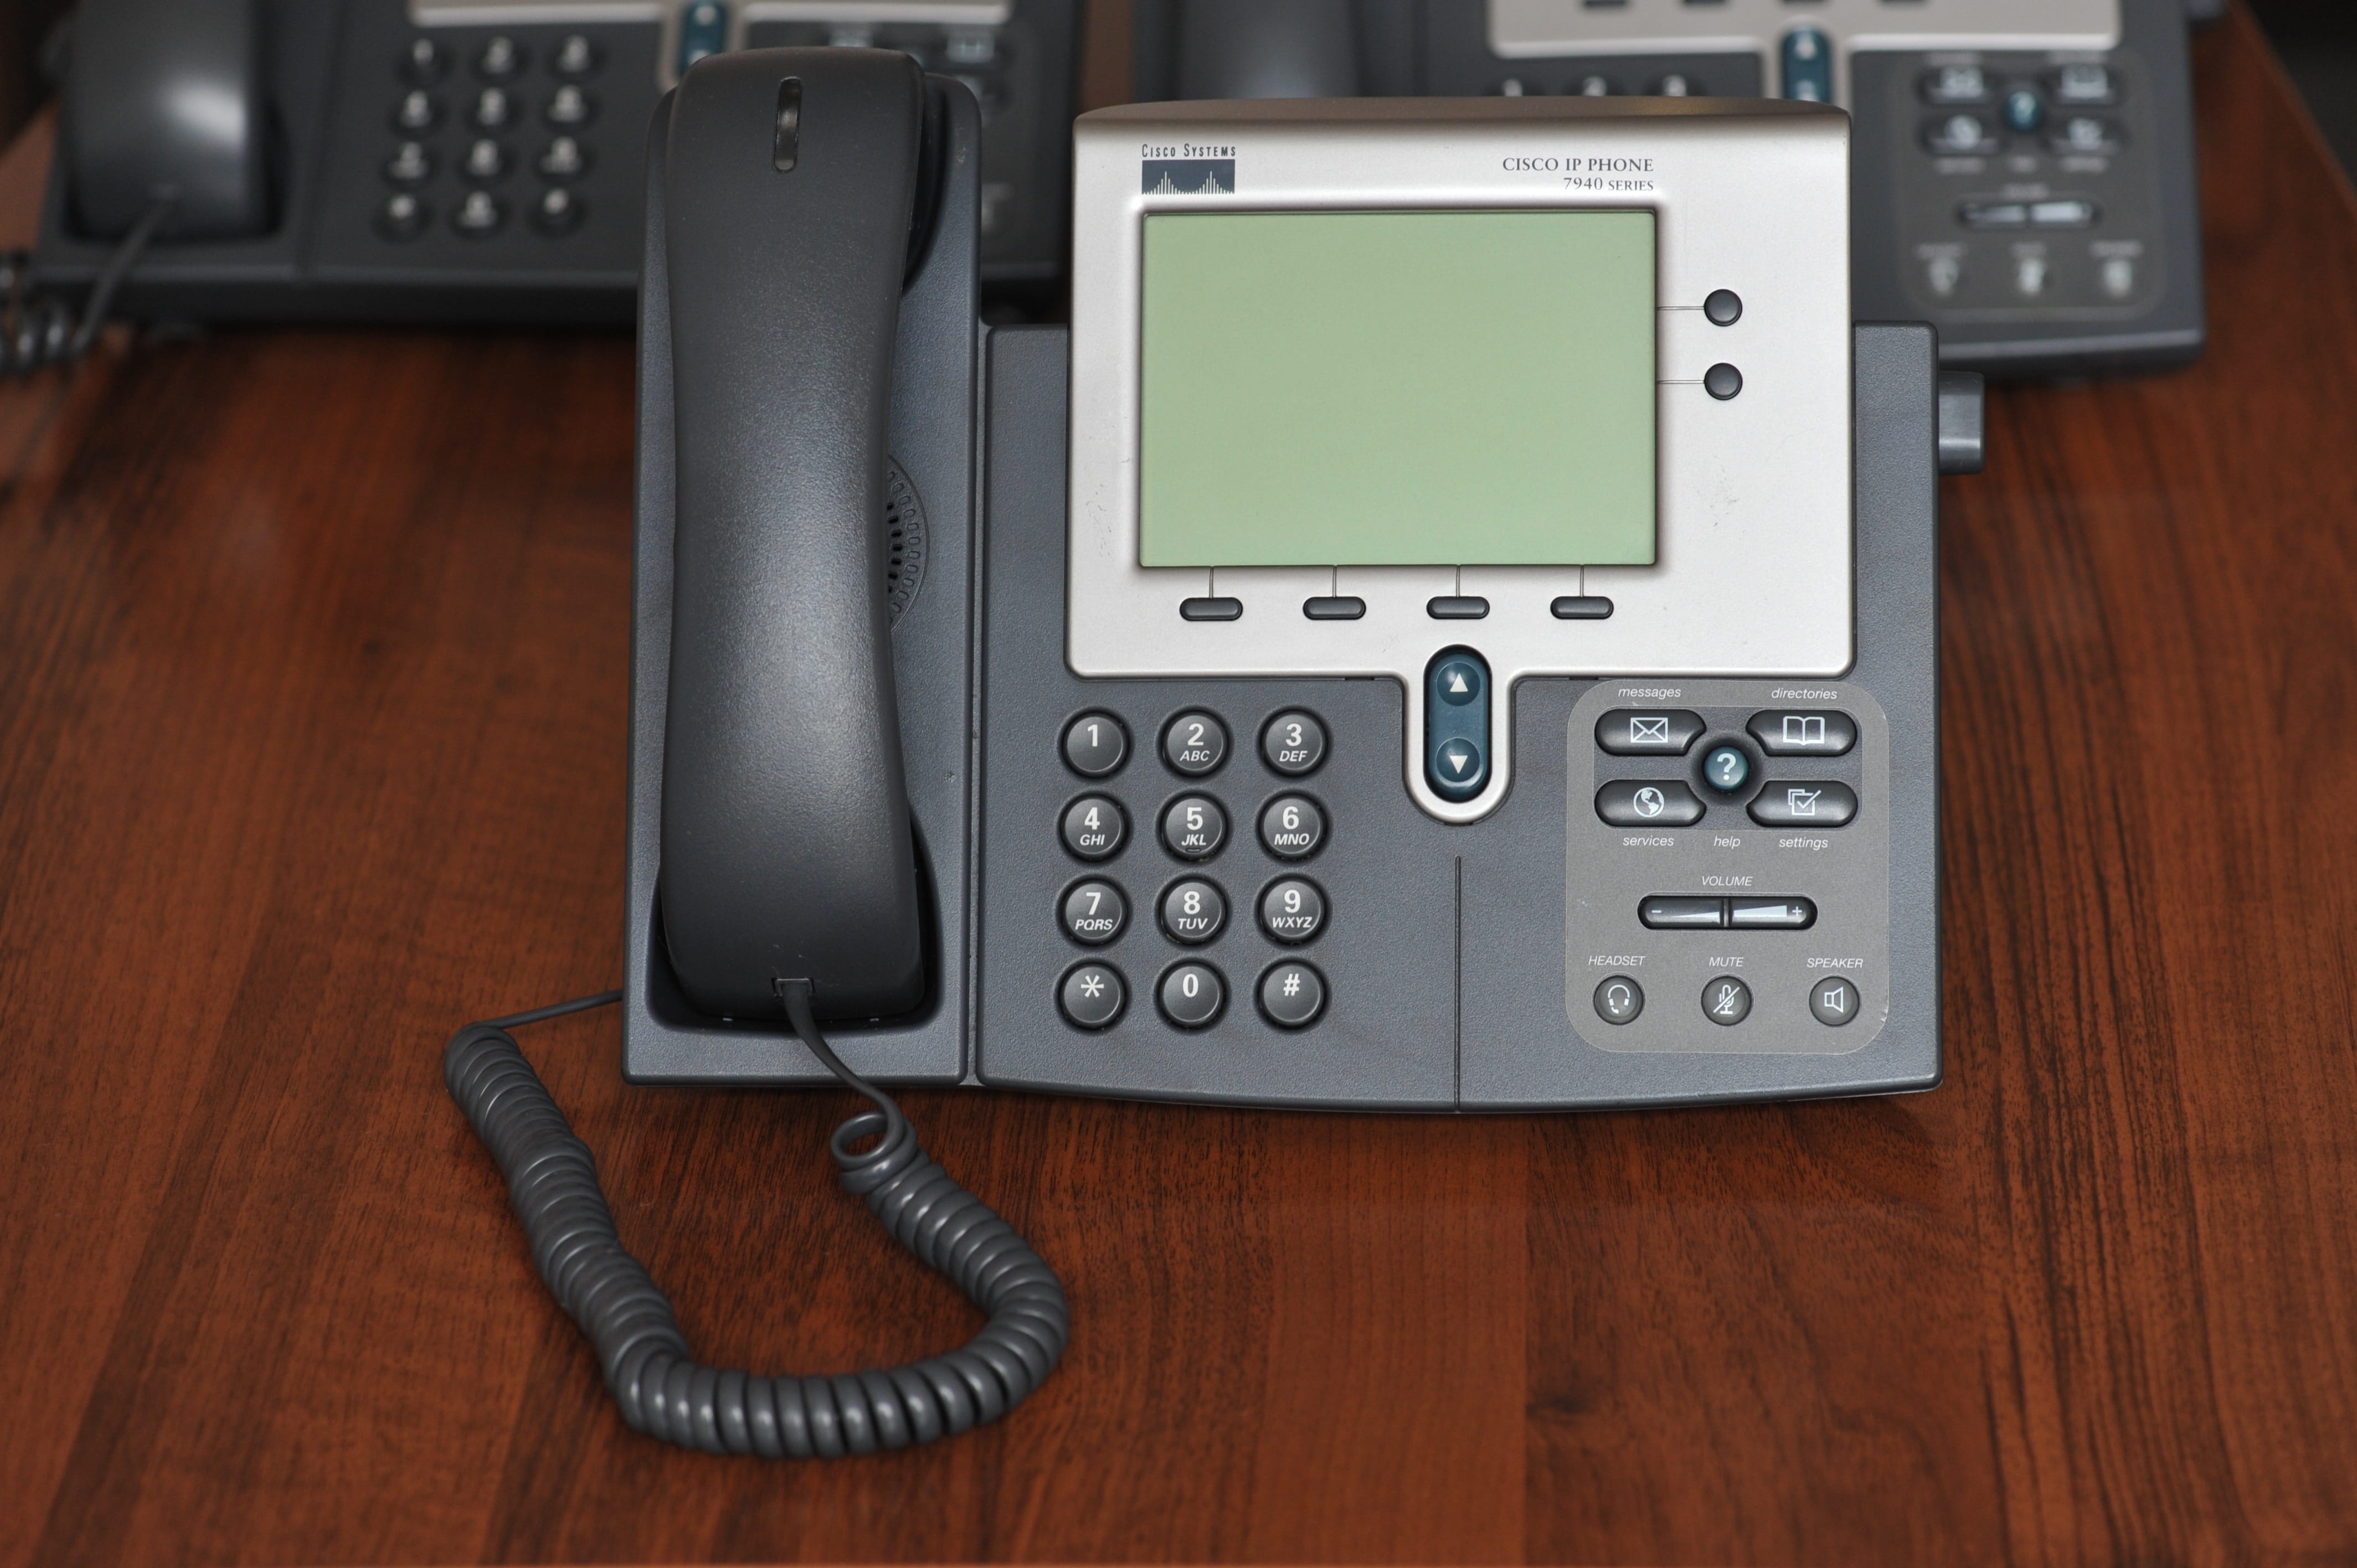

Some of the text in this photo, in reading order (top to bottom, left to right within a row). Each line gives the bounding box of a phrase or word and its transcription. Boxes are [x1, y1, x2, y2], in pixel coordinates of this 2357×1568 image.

[1502, 158, 1654, 172] CISCO IP PHONE
[1563, 177, 1654, 191] 7940 SERIES
[1618, 688, 1681, 700] messages
[1771, 688, 1838, 700] directories
[1087, 724, 1098, 747] 1
[1187, 723, 1204, 746] 2
[1285, 723, 1302, 747] 3
[1180, 750, 1210, 762] ABC
[1279, 750, 1308, 762] DEF
[1084, 807, 1100, 830] 4
[1186, 807, 1203, 831] 5
[1282, 806, 1299, 830] 6
[1079, 834, 1105, 846] GHI
[1181, 834, 1207, 846] JKL
[1274, 833, 1310, 845] MNO
[1623, 836, 1675, 847] services
[1713, 835, 1741, 849] help
[1779, 836, 1829, 849] settings
[1701, 875, 1753, 886] VOLUME
[1085, 892, 1102, 916] 7
[1183, 891, 1201, 915] 8
[1284, 889, 1301, 914] 9
[1074, 919, 1113, 931] PQRS
[1177, 918, 1208, 930] TUV
[1272, 916, 1313, 929] WXYZ
[1588, 955, 1646, 967] HEADSET
[1708, 956, 1744, 967] MUTE
[1807, 957, 1864, 969] SPEAKER
[1182, 973, 1199, 998] 0
